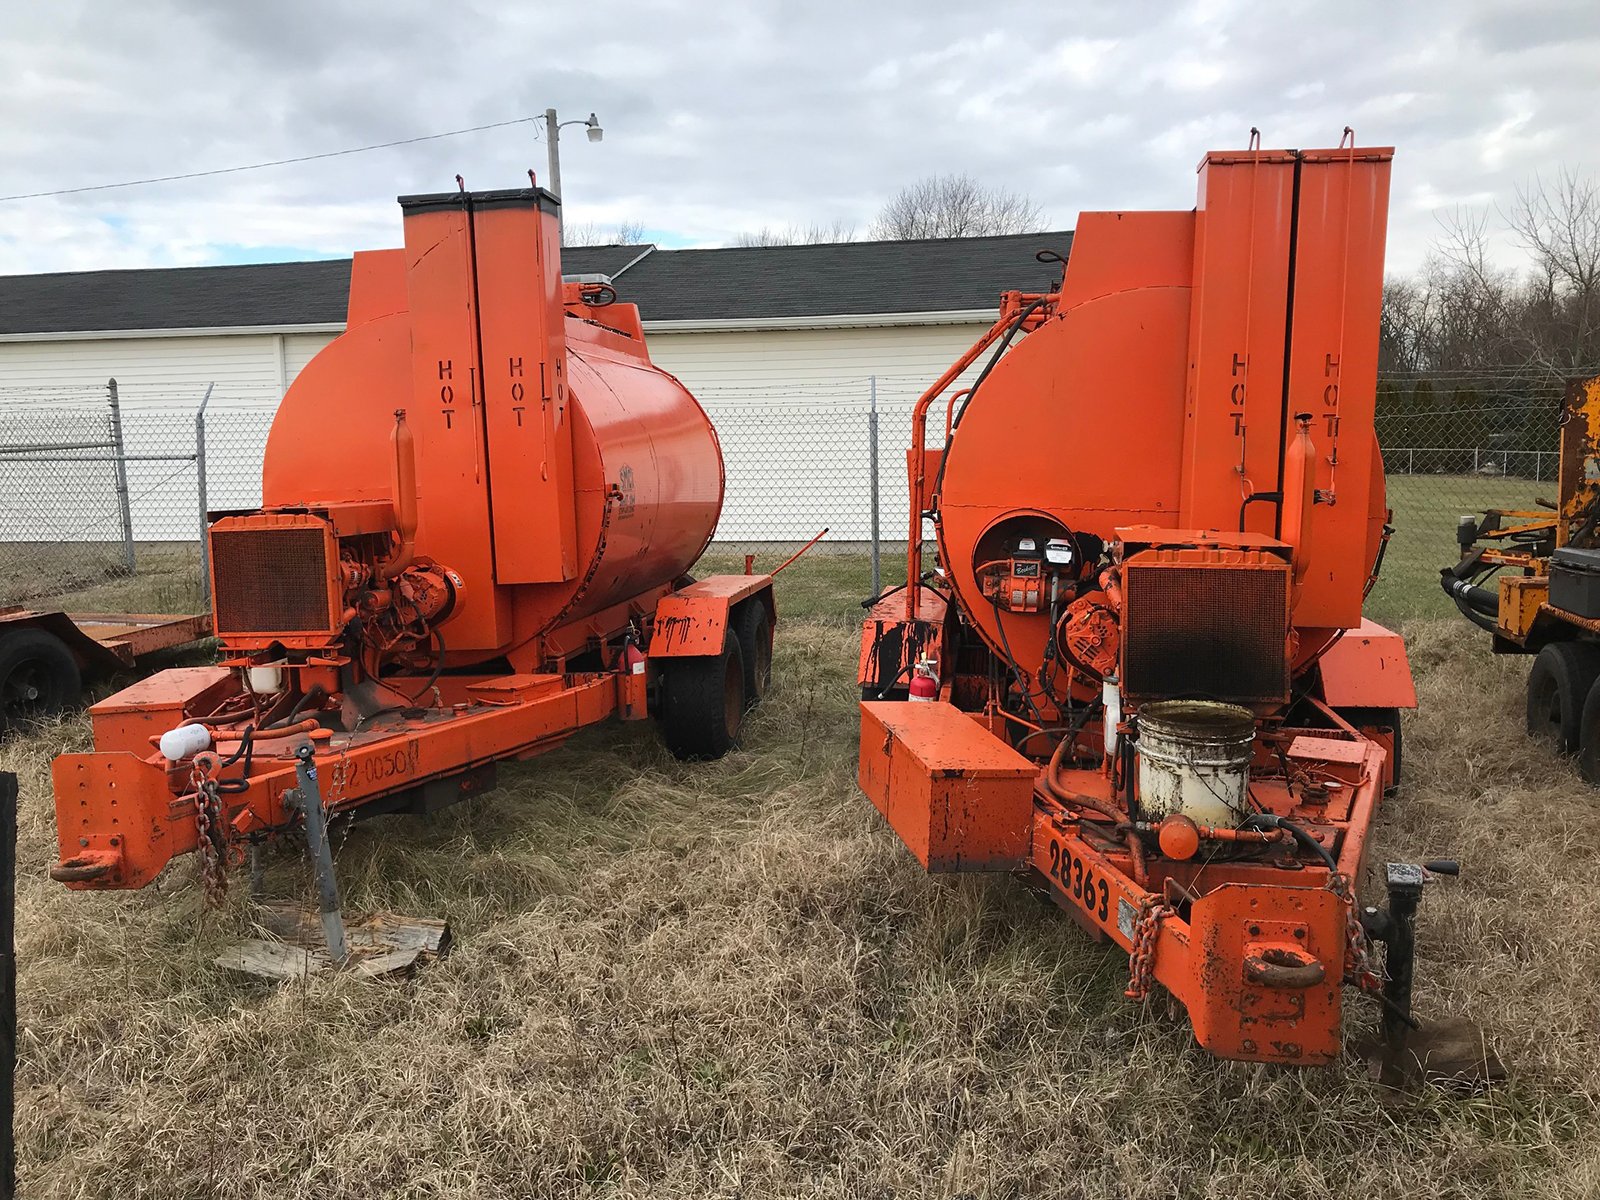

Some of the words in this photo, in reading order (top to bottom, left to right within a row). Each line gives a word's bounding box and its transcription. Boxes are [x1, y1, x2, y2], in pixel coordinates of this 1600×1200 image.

[438, 360, 455, 429] HOT
[508, 357, 526, 427] HOT
[1230, 353, 1250, 436] HOT
[1322, 353, 1342, 437] HOT
[1049, 838, 1110, 923] 28363
